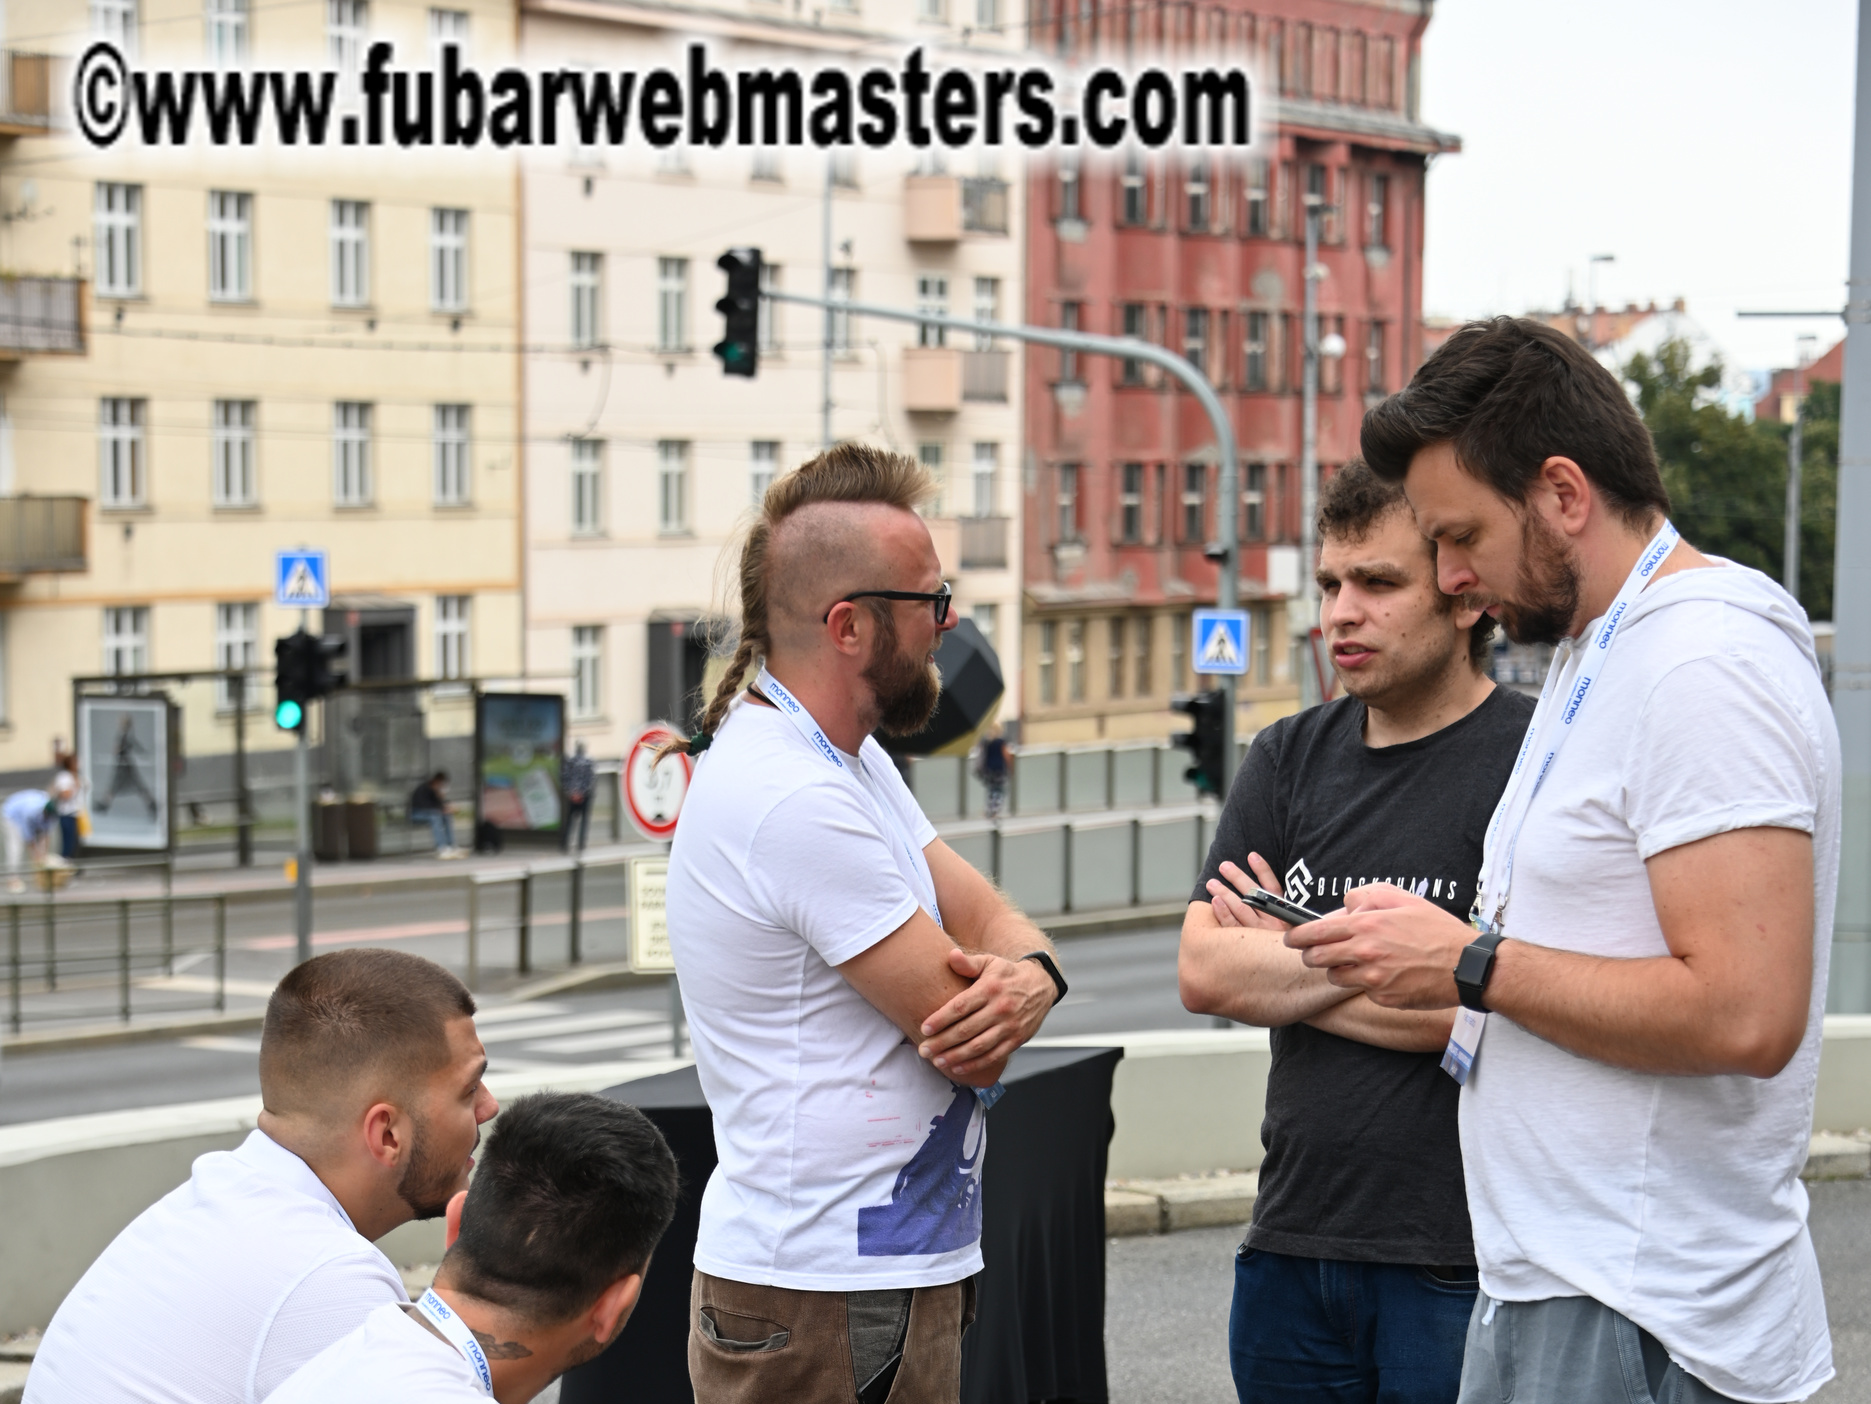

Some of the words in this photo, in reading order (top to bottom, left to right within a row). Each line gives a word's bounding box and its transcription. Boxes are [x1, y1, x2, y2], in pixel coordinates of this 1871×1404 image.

[1640, 541, 1670, 577] monneo
[1598, 601, 1628, 650] monneo
[769, 682, 800, 713] monneo
[1564, 676, 1592, 725] monneo
[813, 731, 843, 768] monneo
[424, 1292, 451, 1320] monneo
[466, 1340, 492, 1392] monneo
